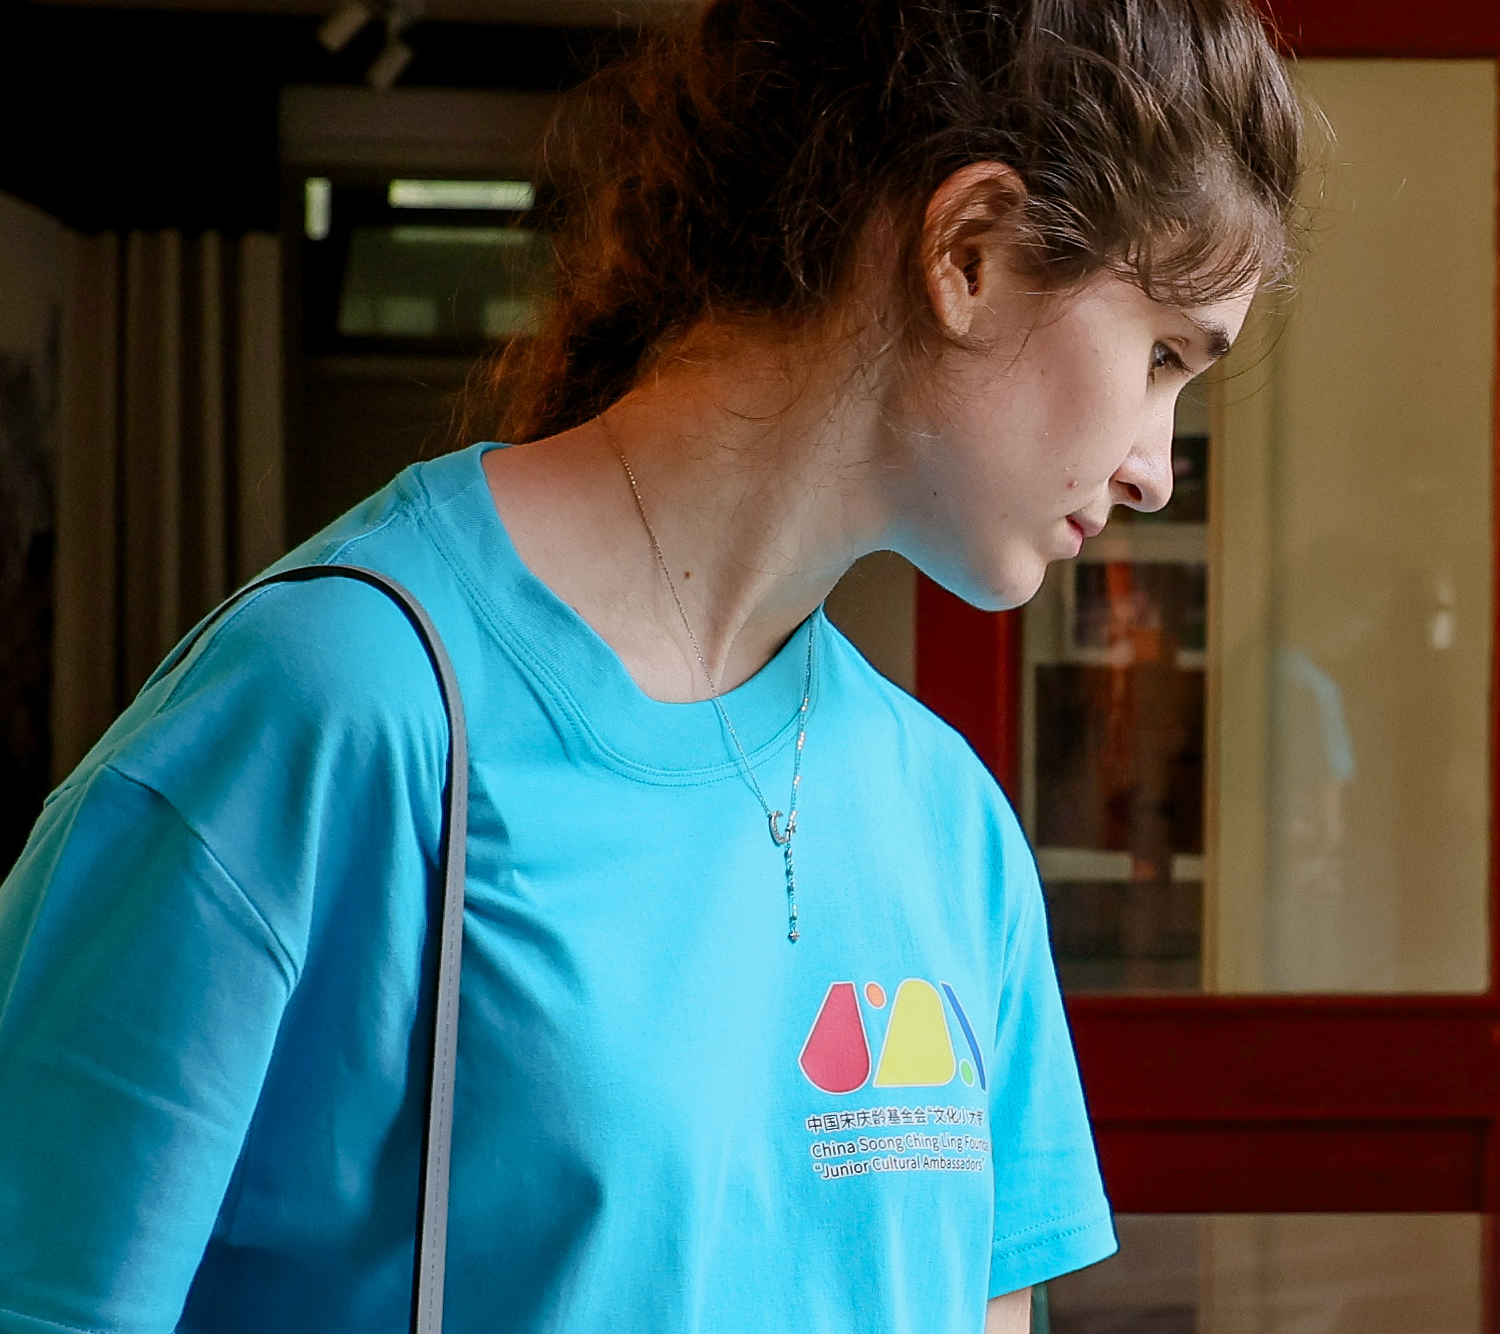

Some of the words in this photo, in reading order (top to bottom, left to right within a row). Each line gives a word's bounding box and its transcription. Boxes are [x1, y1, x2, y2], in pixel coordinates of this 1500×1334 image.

[812, 1141, 856, 1158] China
[859, 1138, 905, 1153] Soong
[905, 1133, 940, 1152] Ching
[941, 1133, 964, 1152] Ling
[872, 1155, 920, 1170] Cultural
